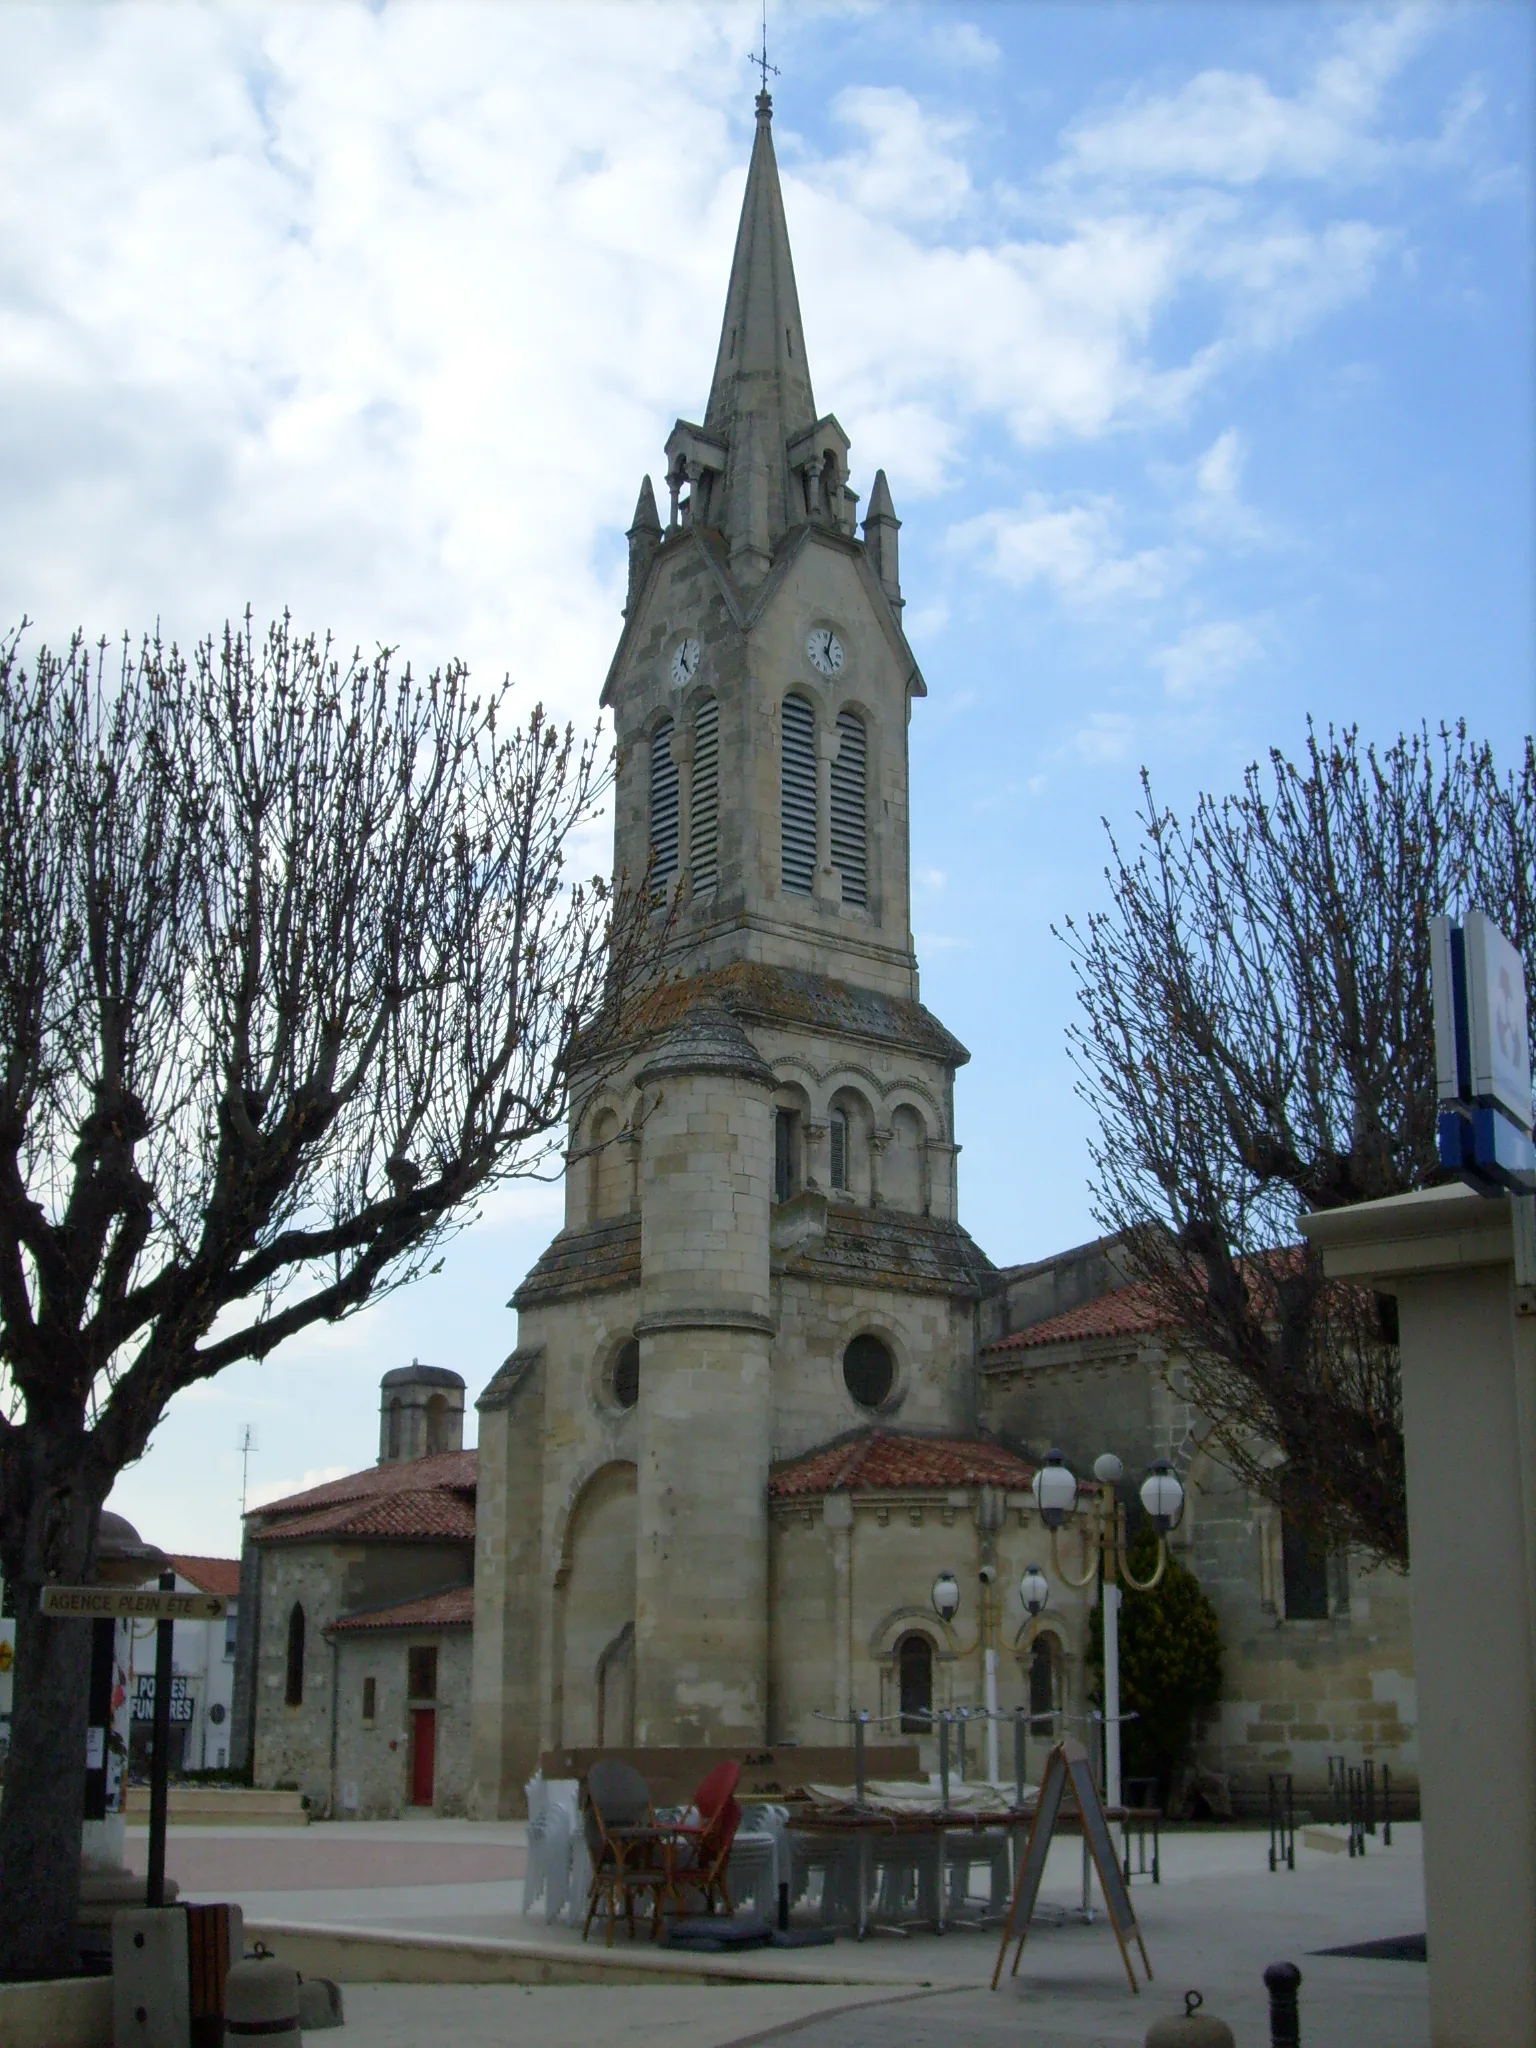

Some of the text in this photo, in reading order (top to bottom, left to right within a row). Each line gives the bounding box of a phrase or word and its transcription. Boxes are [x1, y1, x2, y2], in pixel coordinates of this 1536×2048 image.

[48, 1594, 112, 1611] AGENCE
[118, 1596, 161, 1612] PLEIN
[140, 1678, 186, 1698] POES
[131, 1698, 191, 1720] FUNRES
